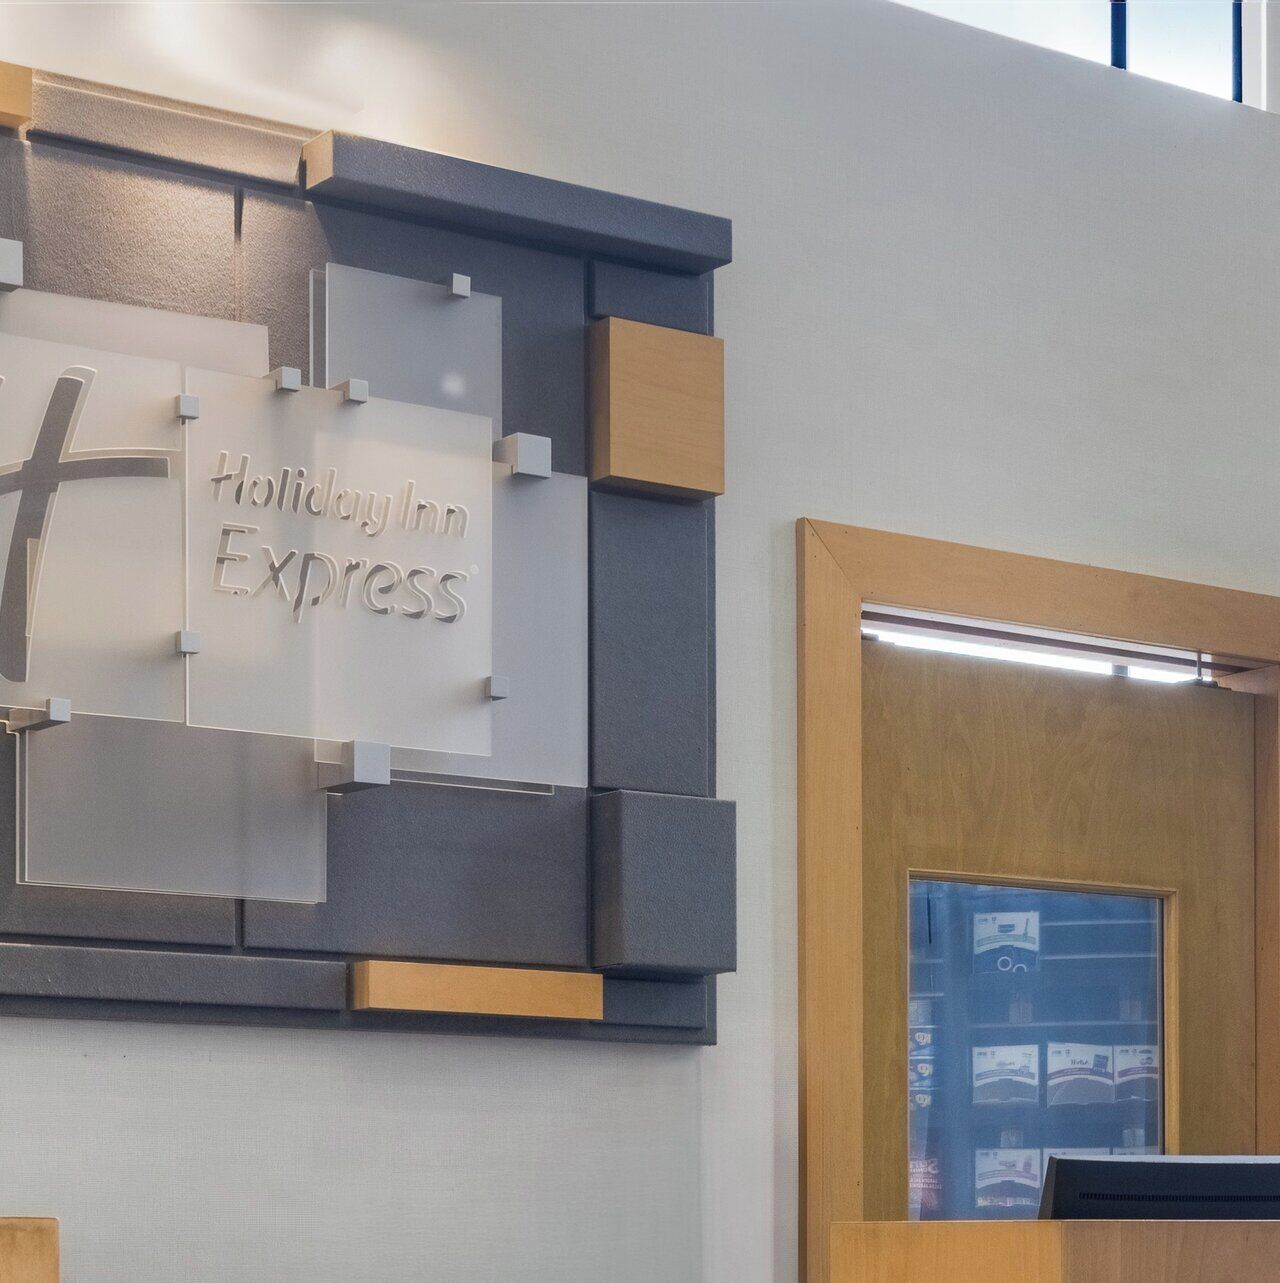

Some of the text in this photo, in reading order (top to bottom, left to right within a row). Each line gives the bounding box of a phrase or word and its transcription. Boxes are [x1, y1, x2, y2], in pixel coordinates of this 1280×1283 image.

[210, 449, 470, 538] Holiday Inn
[212, 521, 470, 624] Express
